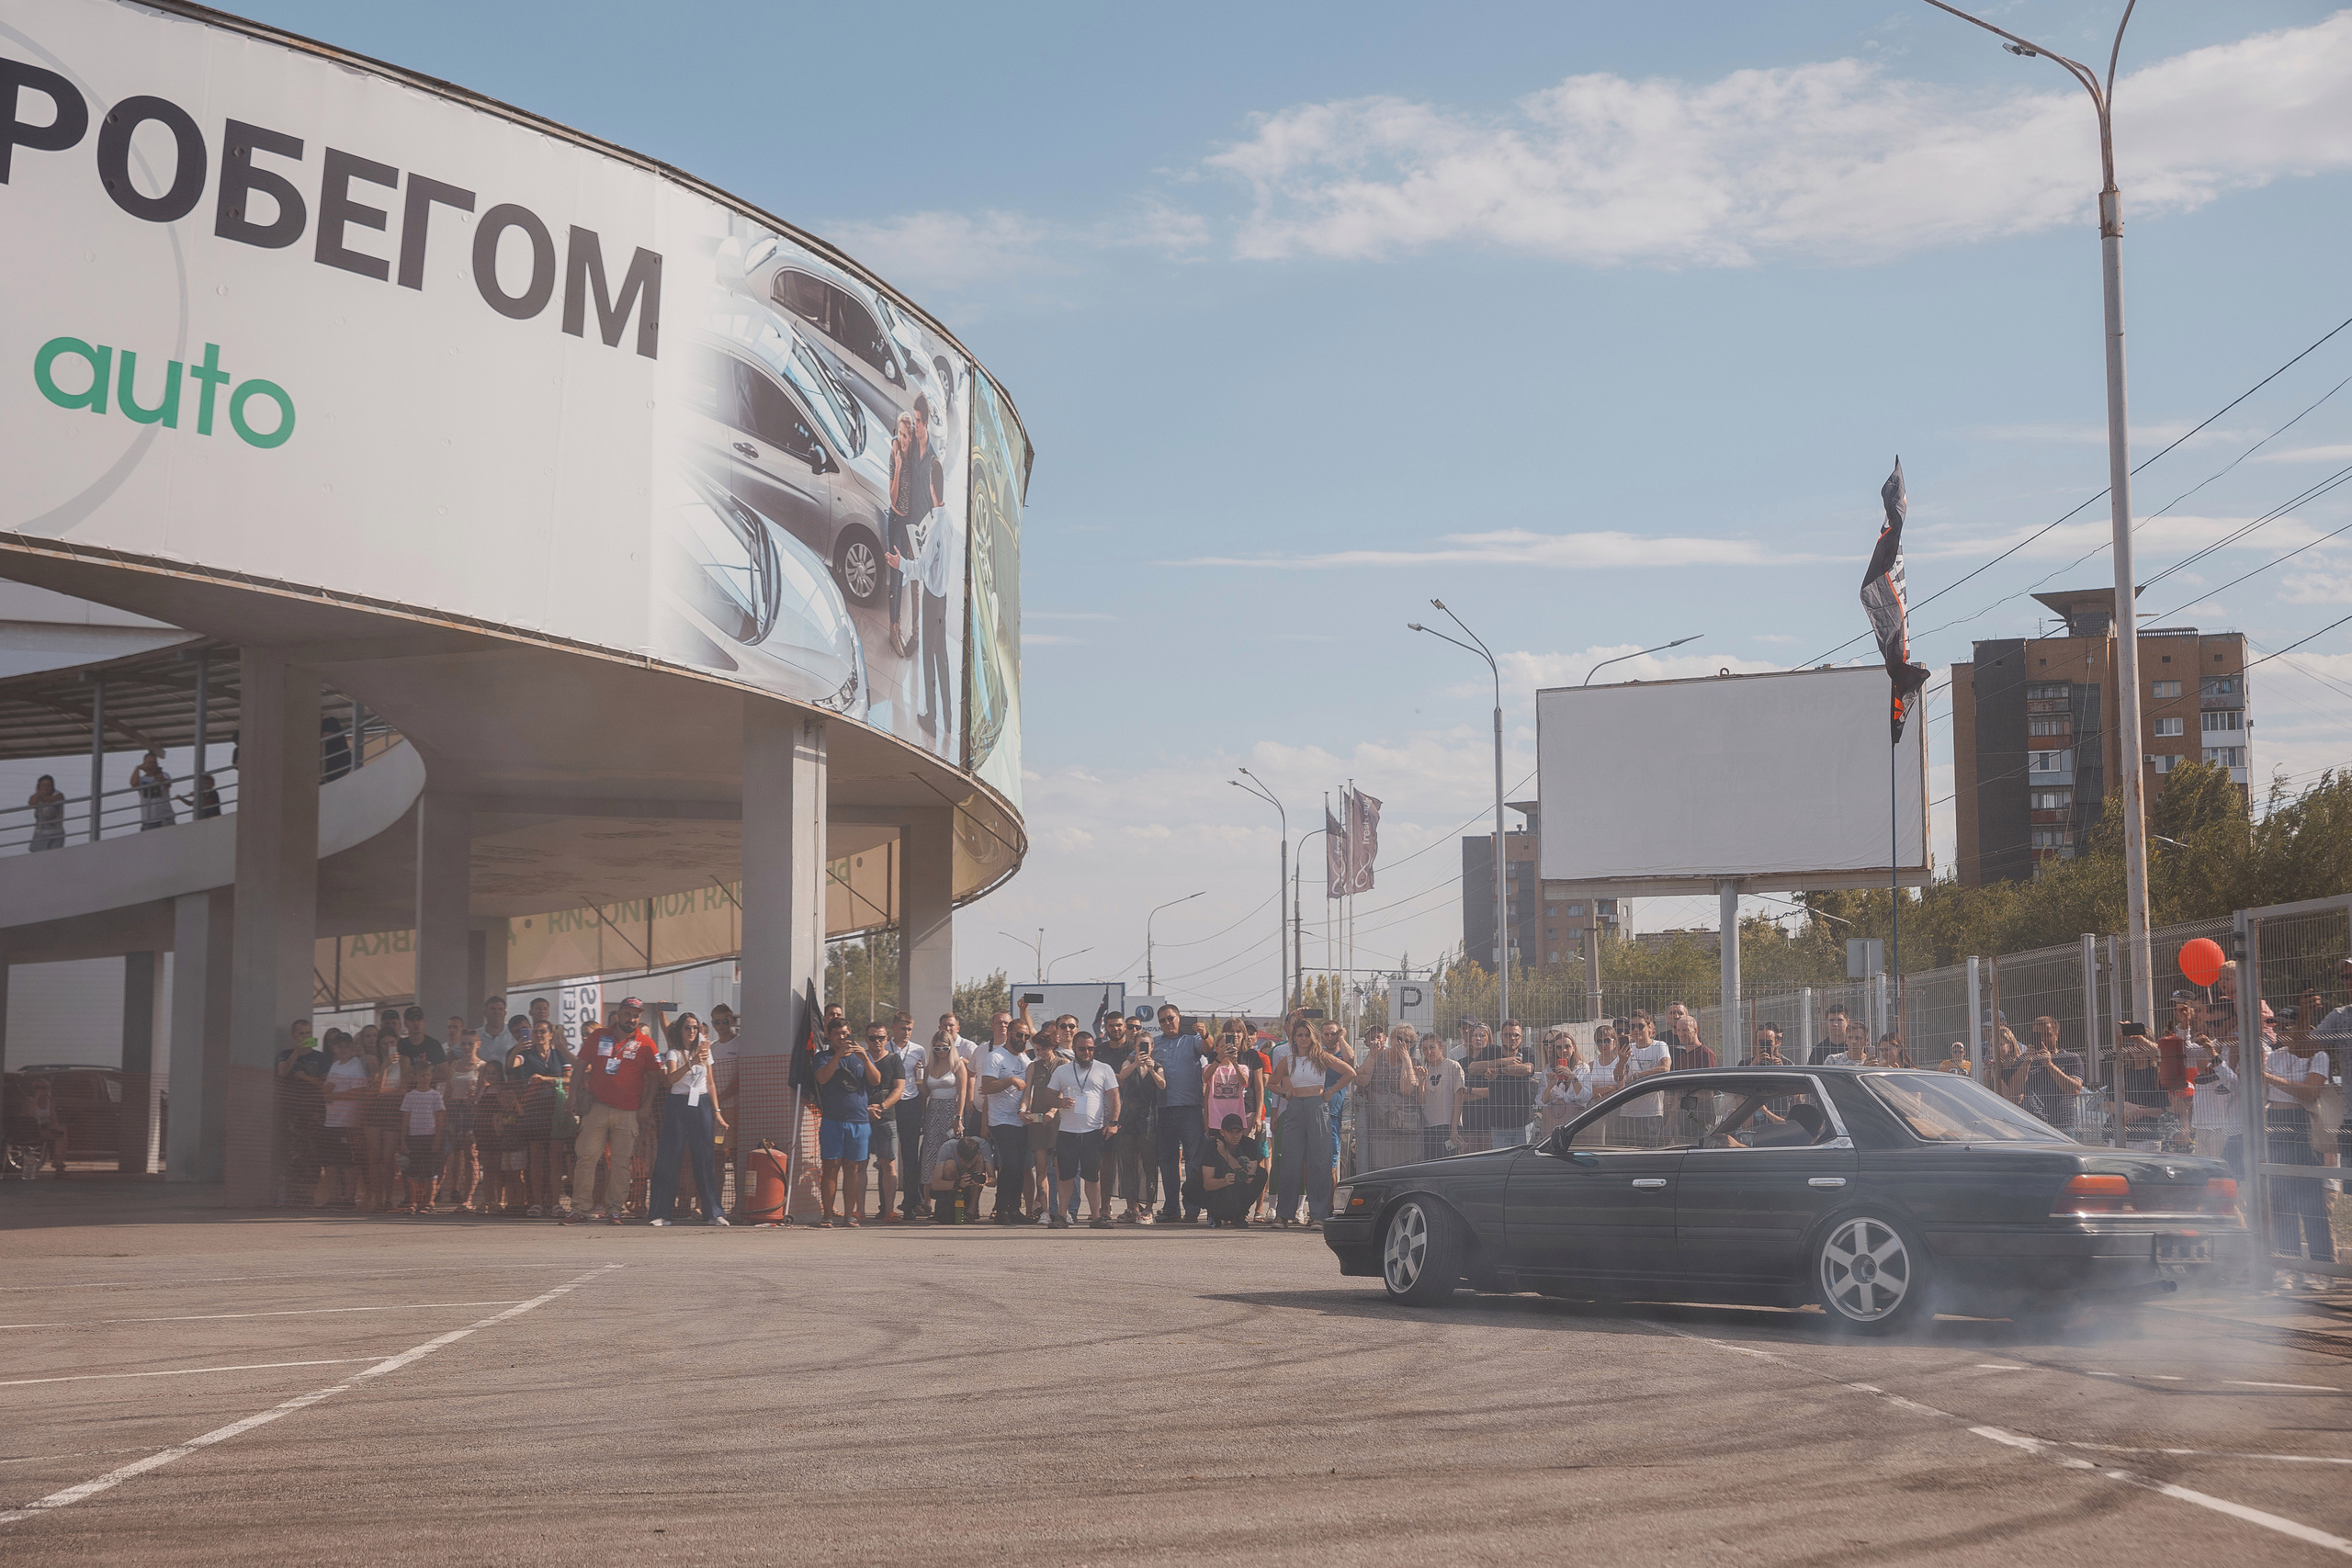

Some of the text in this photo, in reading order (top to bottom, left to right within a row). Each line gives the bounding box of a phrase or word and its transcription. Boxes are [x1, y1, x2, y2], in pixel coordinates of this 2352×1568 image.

[0, 57, 662, 361] РОБЕГОМ
[33, 336, 296, 450] auto
[1362, 818, 1370, 845] fresh
[1399, 986, 1423, 1020] P
